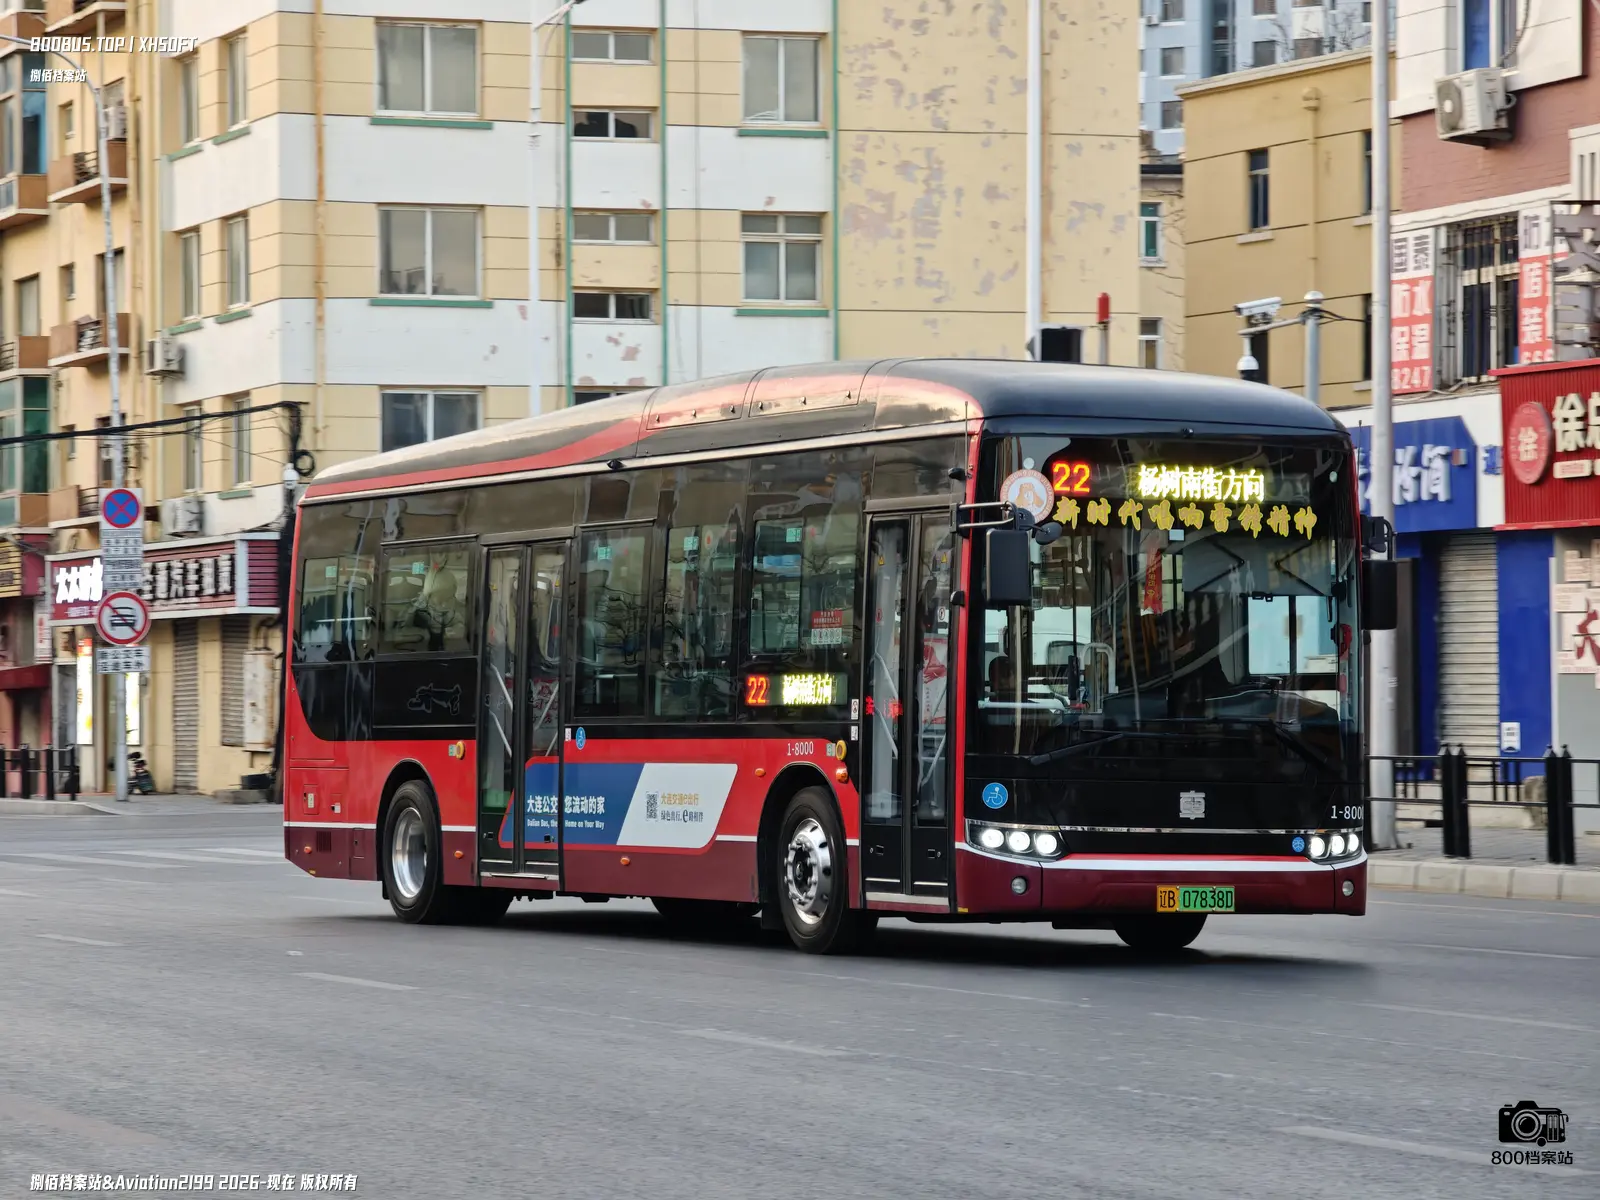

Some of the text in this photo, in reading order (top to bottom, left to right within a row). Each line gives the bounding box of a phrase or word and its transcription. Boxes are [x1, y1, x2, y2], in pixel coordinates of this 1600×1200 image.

[1053, 462, 1090, 493] 22
[1138, 464, 1264, 502] 杨树南街方向
[1053, 496, 1318, 540] 新时代唱响雷锋精神
[746, 676, 768, 705] 22
[786, 740, 814, 756] 1-8000
[527, 795, 605, 815] 大连公交 您流动的家
[527, 818, 540, 827] Dalian
[564, 820, 577, 828] Home
[1159, 890, 1234, 909] 辽B 07838D
